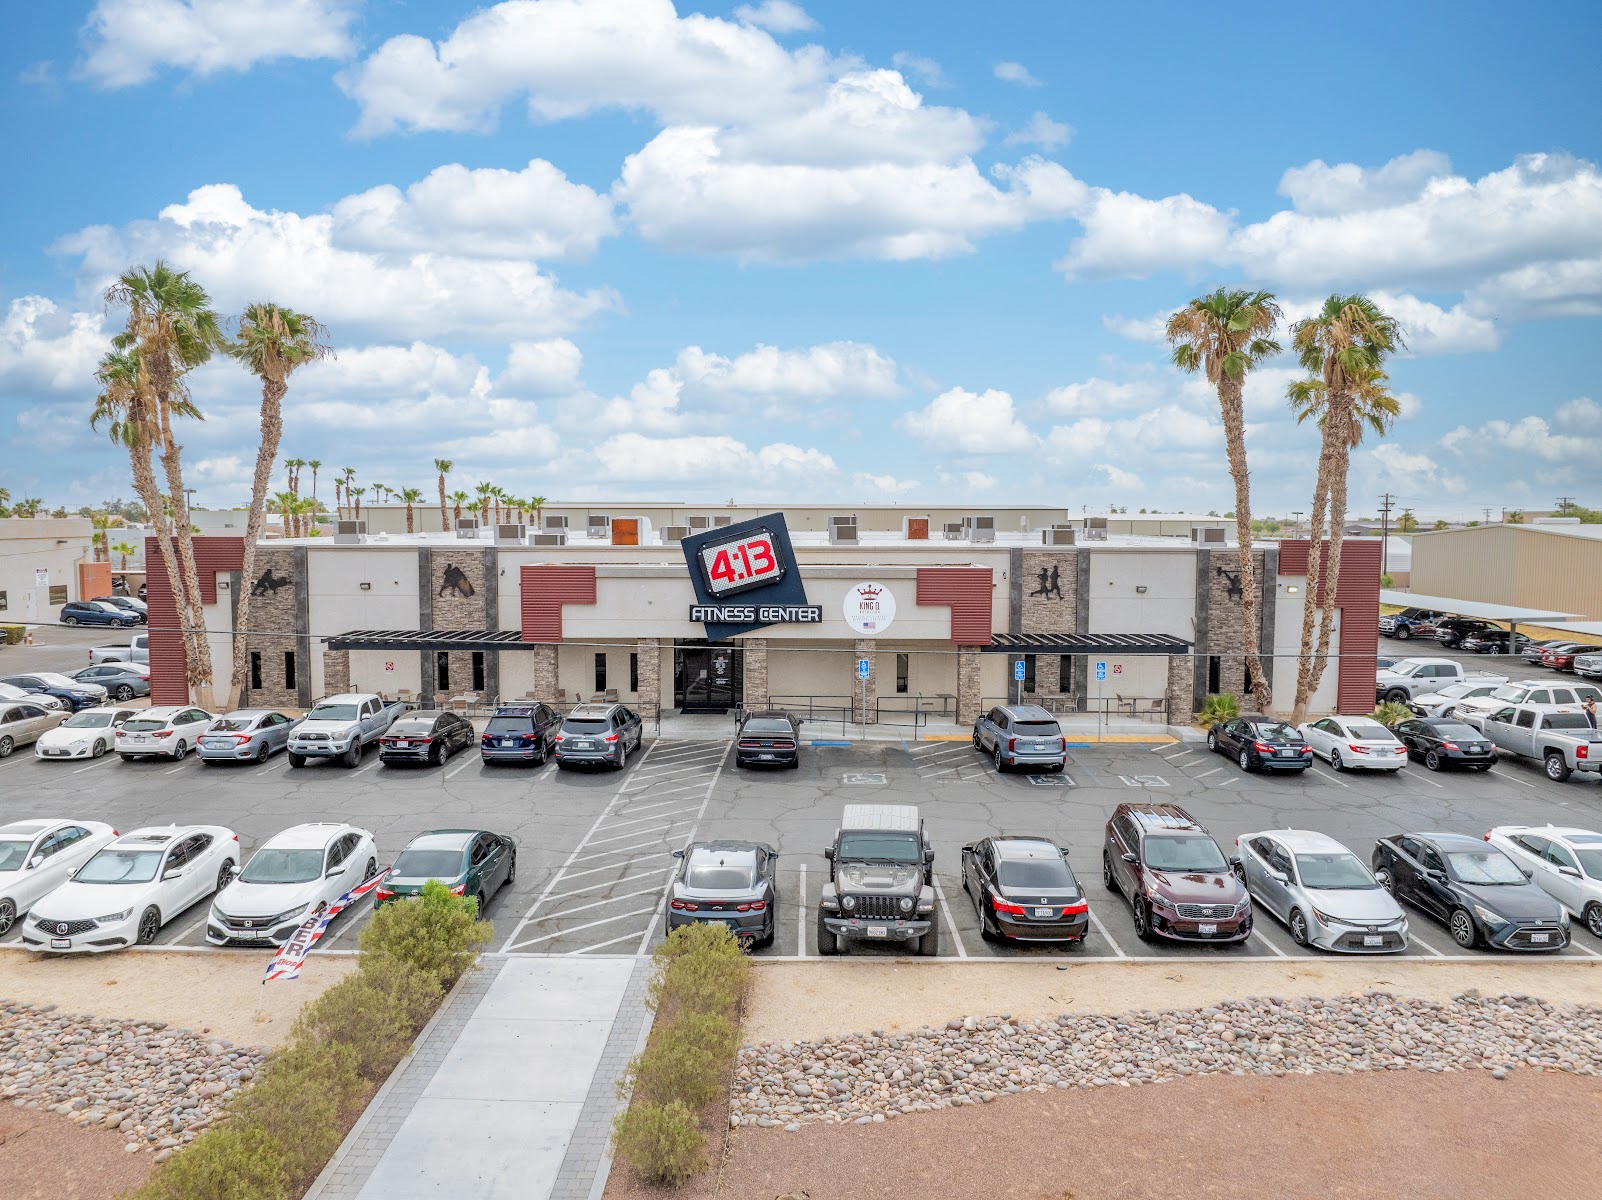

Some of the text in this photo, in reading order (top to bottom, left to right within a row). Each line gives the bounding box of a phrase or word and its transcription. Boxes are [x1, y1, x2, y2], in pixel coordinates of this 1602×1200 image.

[710, 539, 775, 582] 4:13
[859, 601, 874, 610] KING
[692, 607, 820, 621] FITNESS CENTER
